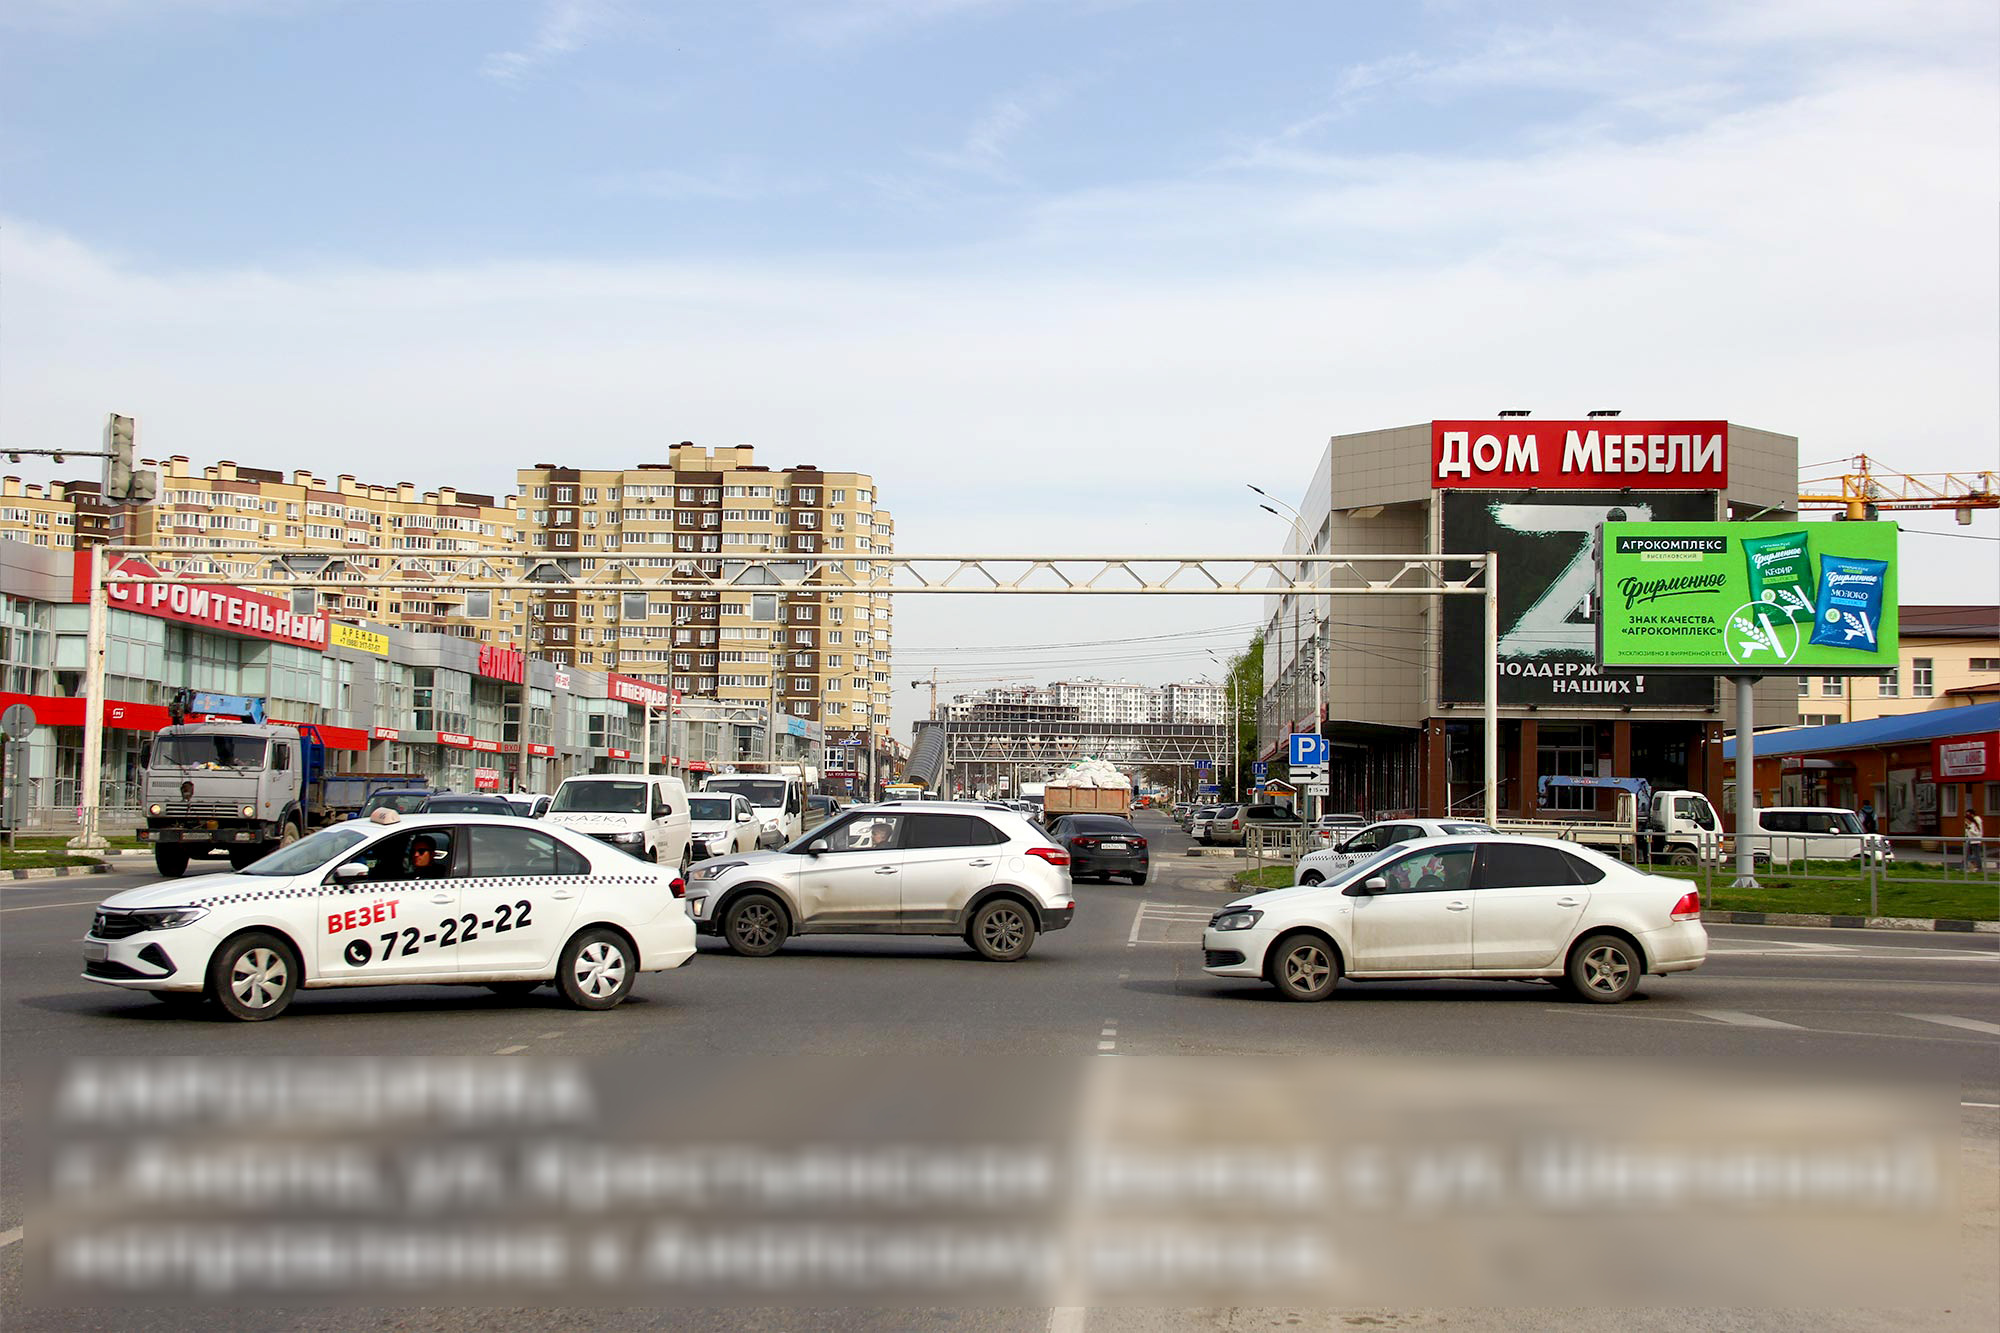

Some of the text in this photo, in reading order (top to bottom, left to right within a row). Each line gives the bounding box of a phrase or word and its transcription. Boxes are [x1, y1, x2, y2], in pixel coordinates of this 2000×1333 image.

[1621, 540, 1722, 550] АГРОКОМПЛЕКС
[1765, 566, 1793, 577] КЕФИР
[1617, 573, 1727, 611] Фирменное
[1831, 588, 1869, 601] МОЛОКО
[109, 570, 325, 643] СТРОИТЕЛЬНЫЙ
[1629, 615, 1715, 624] ЗНАК КАЧЕСТВА
[342, 627, 379, 643] АРЕНДА
[1621, 626, 1723, 636] «АГРОКОМПЛЕКС»
[1497, 662, 1599, 677] ПОДДЕРЖ
[553, 815, 628, 825] SKAZKA
[328, 898, 399, 935] ВЕЗЁТ
[380, 899, 532, 962] 72-22-22
